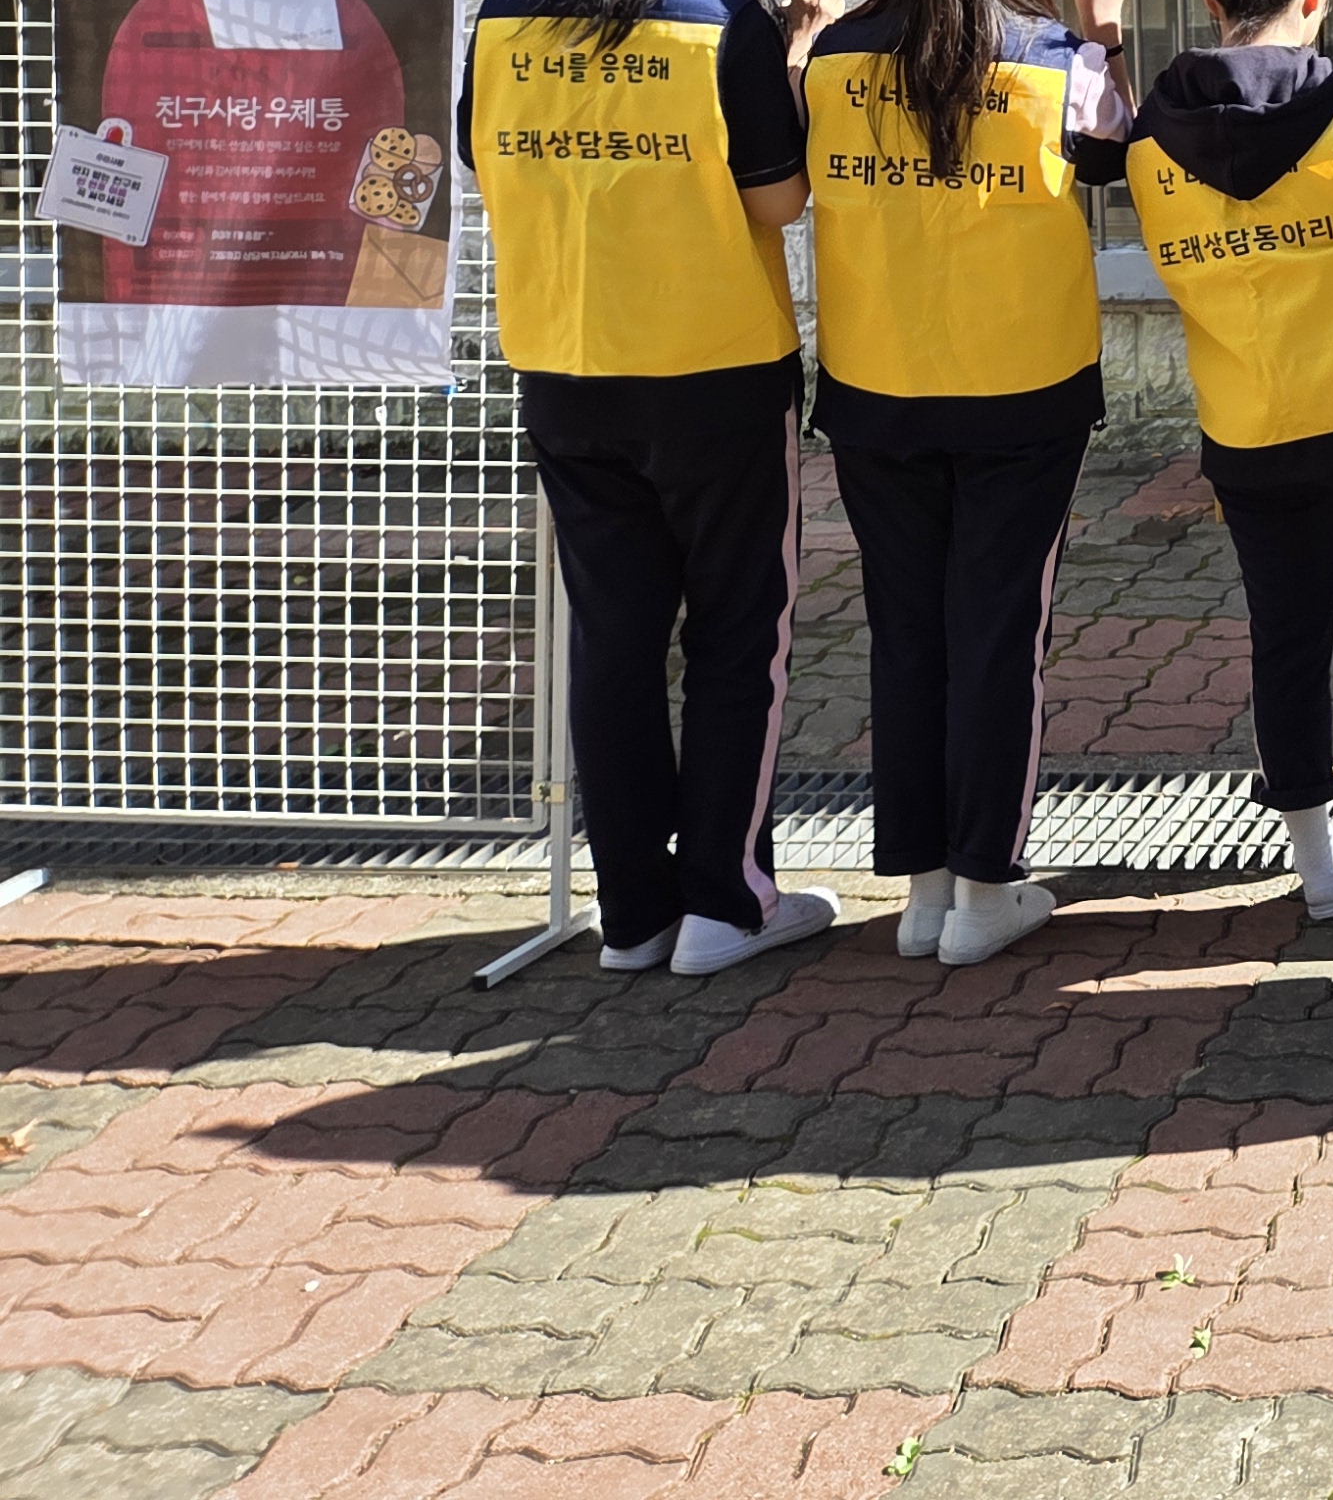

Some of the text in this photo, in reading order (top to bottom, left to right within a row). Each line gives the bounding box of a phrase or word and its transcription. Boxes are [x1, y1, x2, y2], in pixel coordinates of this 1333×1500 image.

[511, 52, 670, 84] 난 너를 응원해
[845, 78, 868, 108] 난
[155, 95, 350, 132] 친구사랑 우체통
[497, 130, 693, 162] 또래상담동아리
[826, 153, 1024, 193] 또래상담동아리
[1157, 167, 1175, 195] 난
